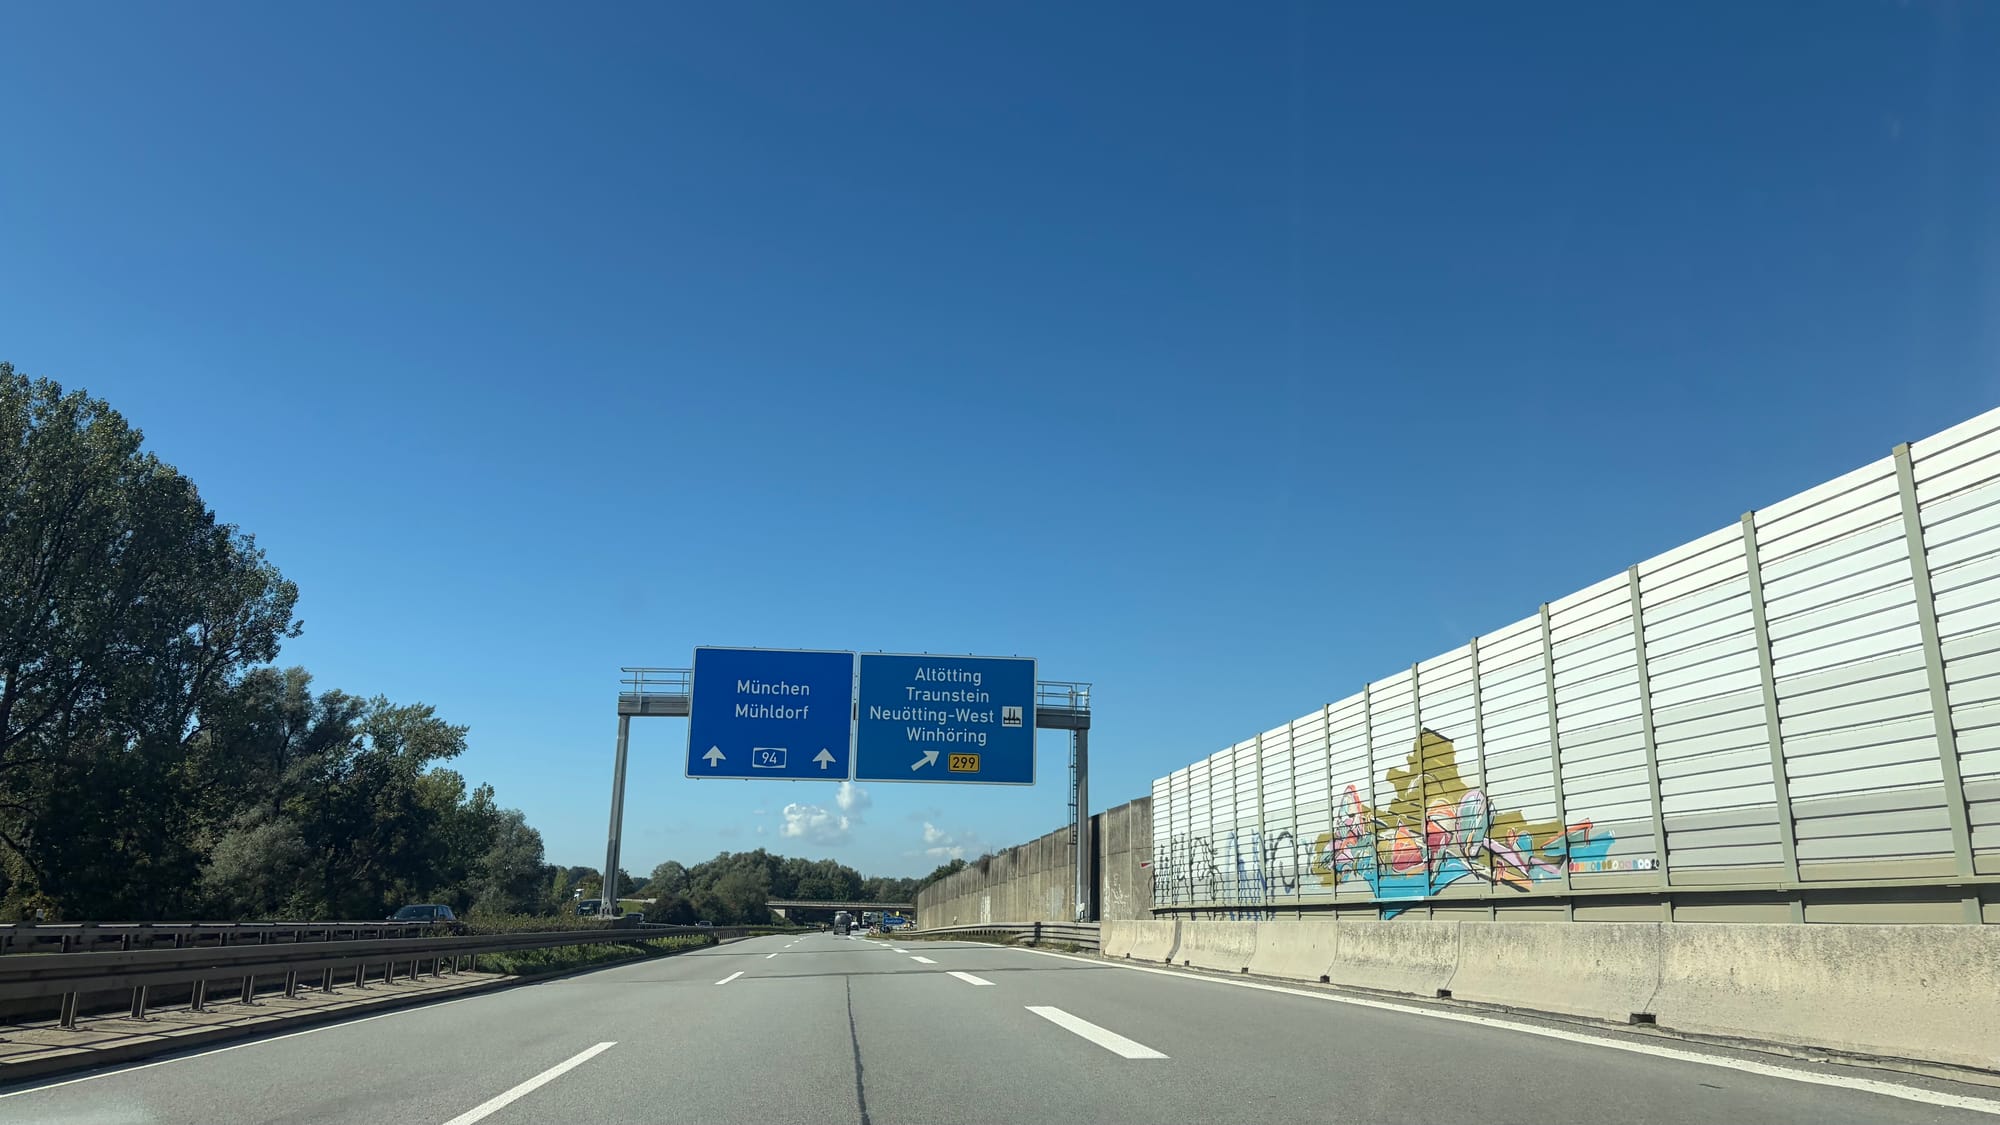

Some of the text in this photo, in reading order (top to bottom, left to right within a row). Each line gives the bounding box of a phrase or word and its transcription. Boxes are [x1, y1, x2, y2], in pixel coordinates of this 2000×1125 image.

[914, 667, 982, 687] Altötting
[737, 679, 810, 696] München
[905, 686, 989, 703] Traunstein
[735, 703, 809, 720] Mühldorf
[869, 705, 994, 725] Neuötting-West
[906, 726, 987, 747] Winhöring
[762, 751, 777, 764] 94
[952, 756, 976, 769] 299
